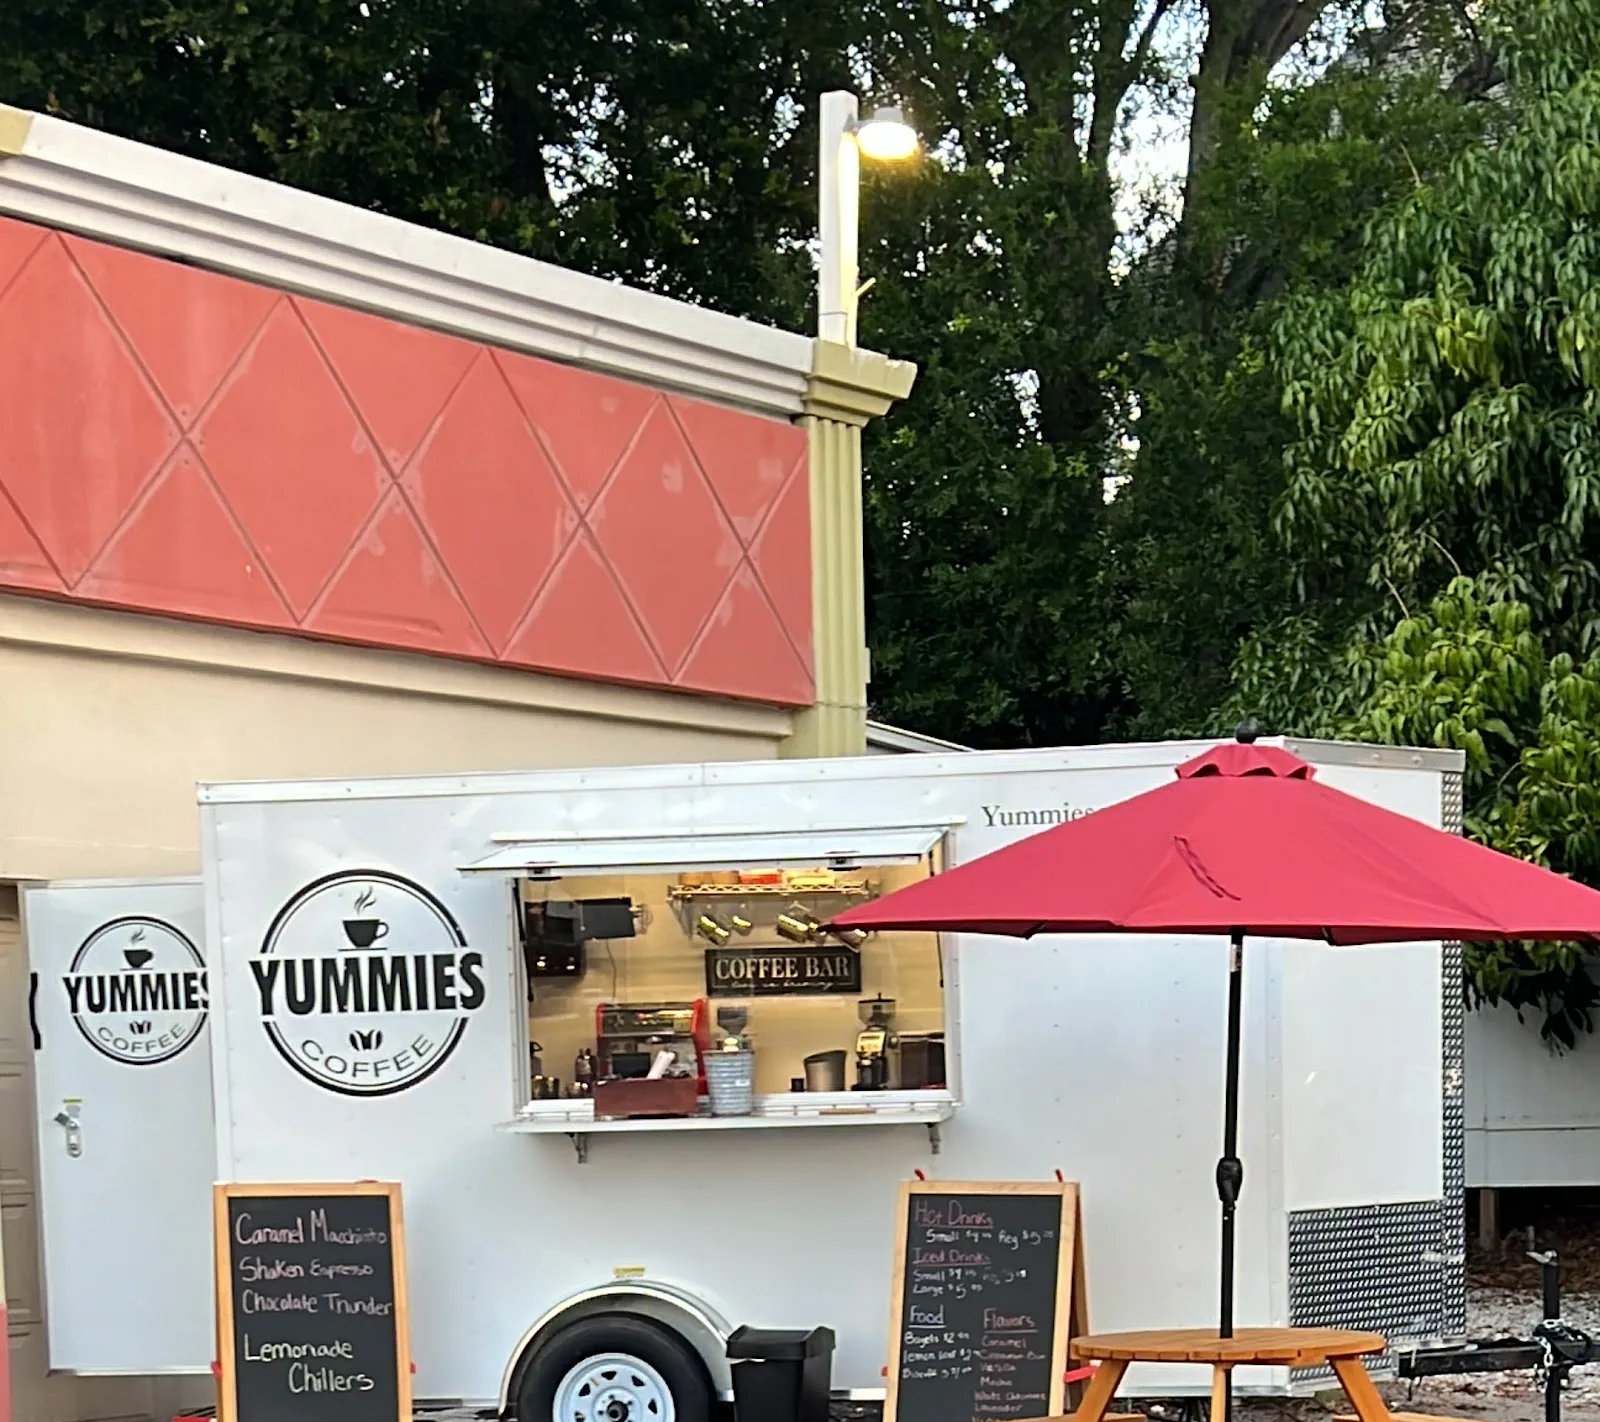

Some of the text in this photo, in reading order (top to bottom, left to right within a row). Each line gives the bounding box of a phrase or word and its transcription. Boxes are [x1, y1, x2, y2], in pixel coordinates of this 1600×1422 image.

[716, 956, 849, 980] COFFEE BAR
[248, 952, 486, 1016] YUMMIES
[97, 1023, 187, 1053] COFFEE
[301, 1034, 435, 1078] COFFEE
[235, 1213, 304, 1244] Caramel
[926, 1229, 960, 1243] Small
[912, 1248, 945, 1264] Iced
[913, 1269, 945, 1282] Small
[242, 1288, 319, 1314] Chocolate
[910, 1305, 944, 1324] Food
[983, 1308, 1035, 1329] Flavors
[244, 1333, 354, 1362] Lemonade
[289, 1362, 375, 1394] Chillers
